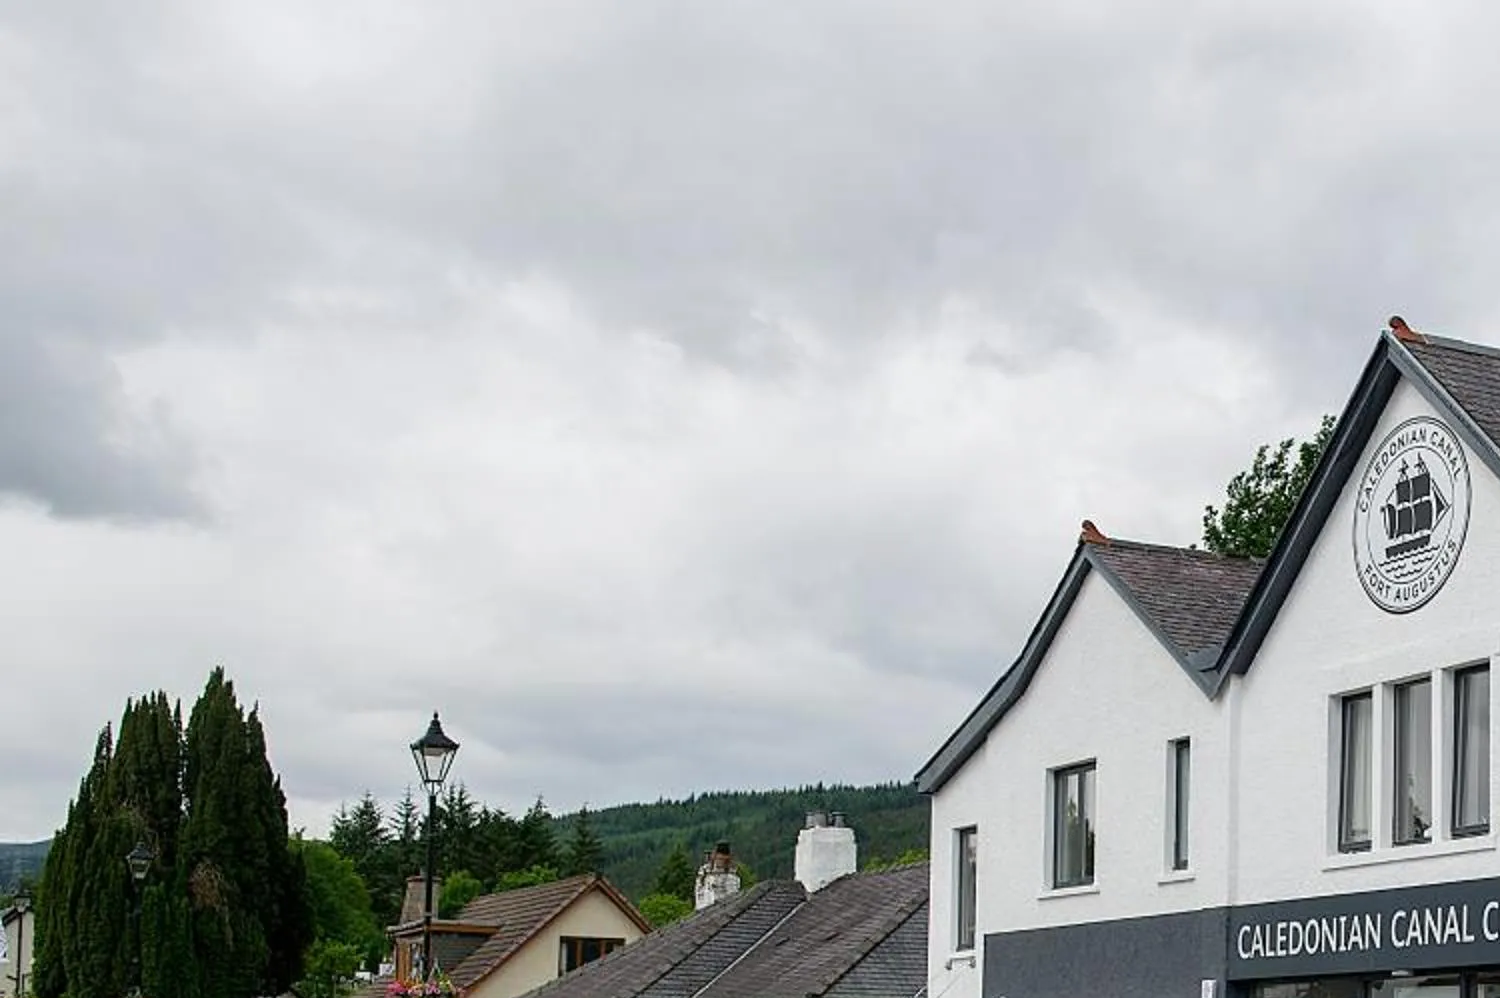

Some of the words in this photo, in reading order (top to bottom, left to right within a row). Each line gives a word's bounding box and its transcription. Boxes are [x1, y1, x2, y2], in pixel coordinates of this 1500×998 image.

[1360, 427, 1427, 513] CALEDONIAN
[1429, 431, 1462, 480] CANAL
[1363, 563, 1391, 599] FORT
[1395, 539, 1457, 603] AUGUSTUS
[1237, 912, 1382, 960] CALEDONIAN
[1390, 903, 1475, 948] CANAL
